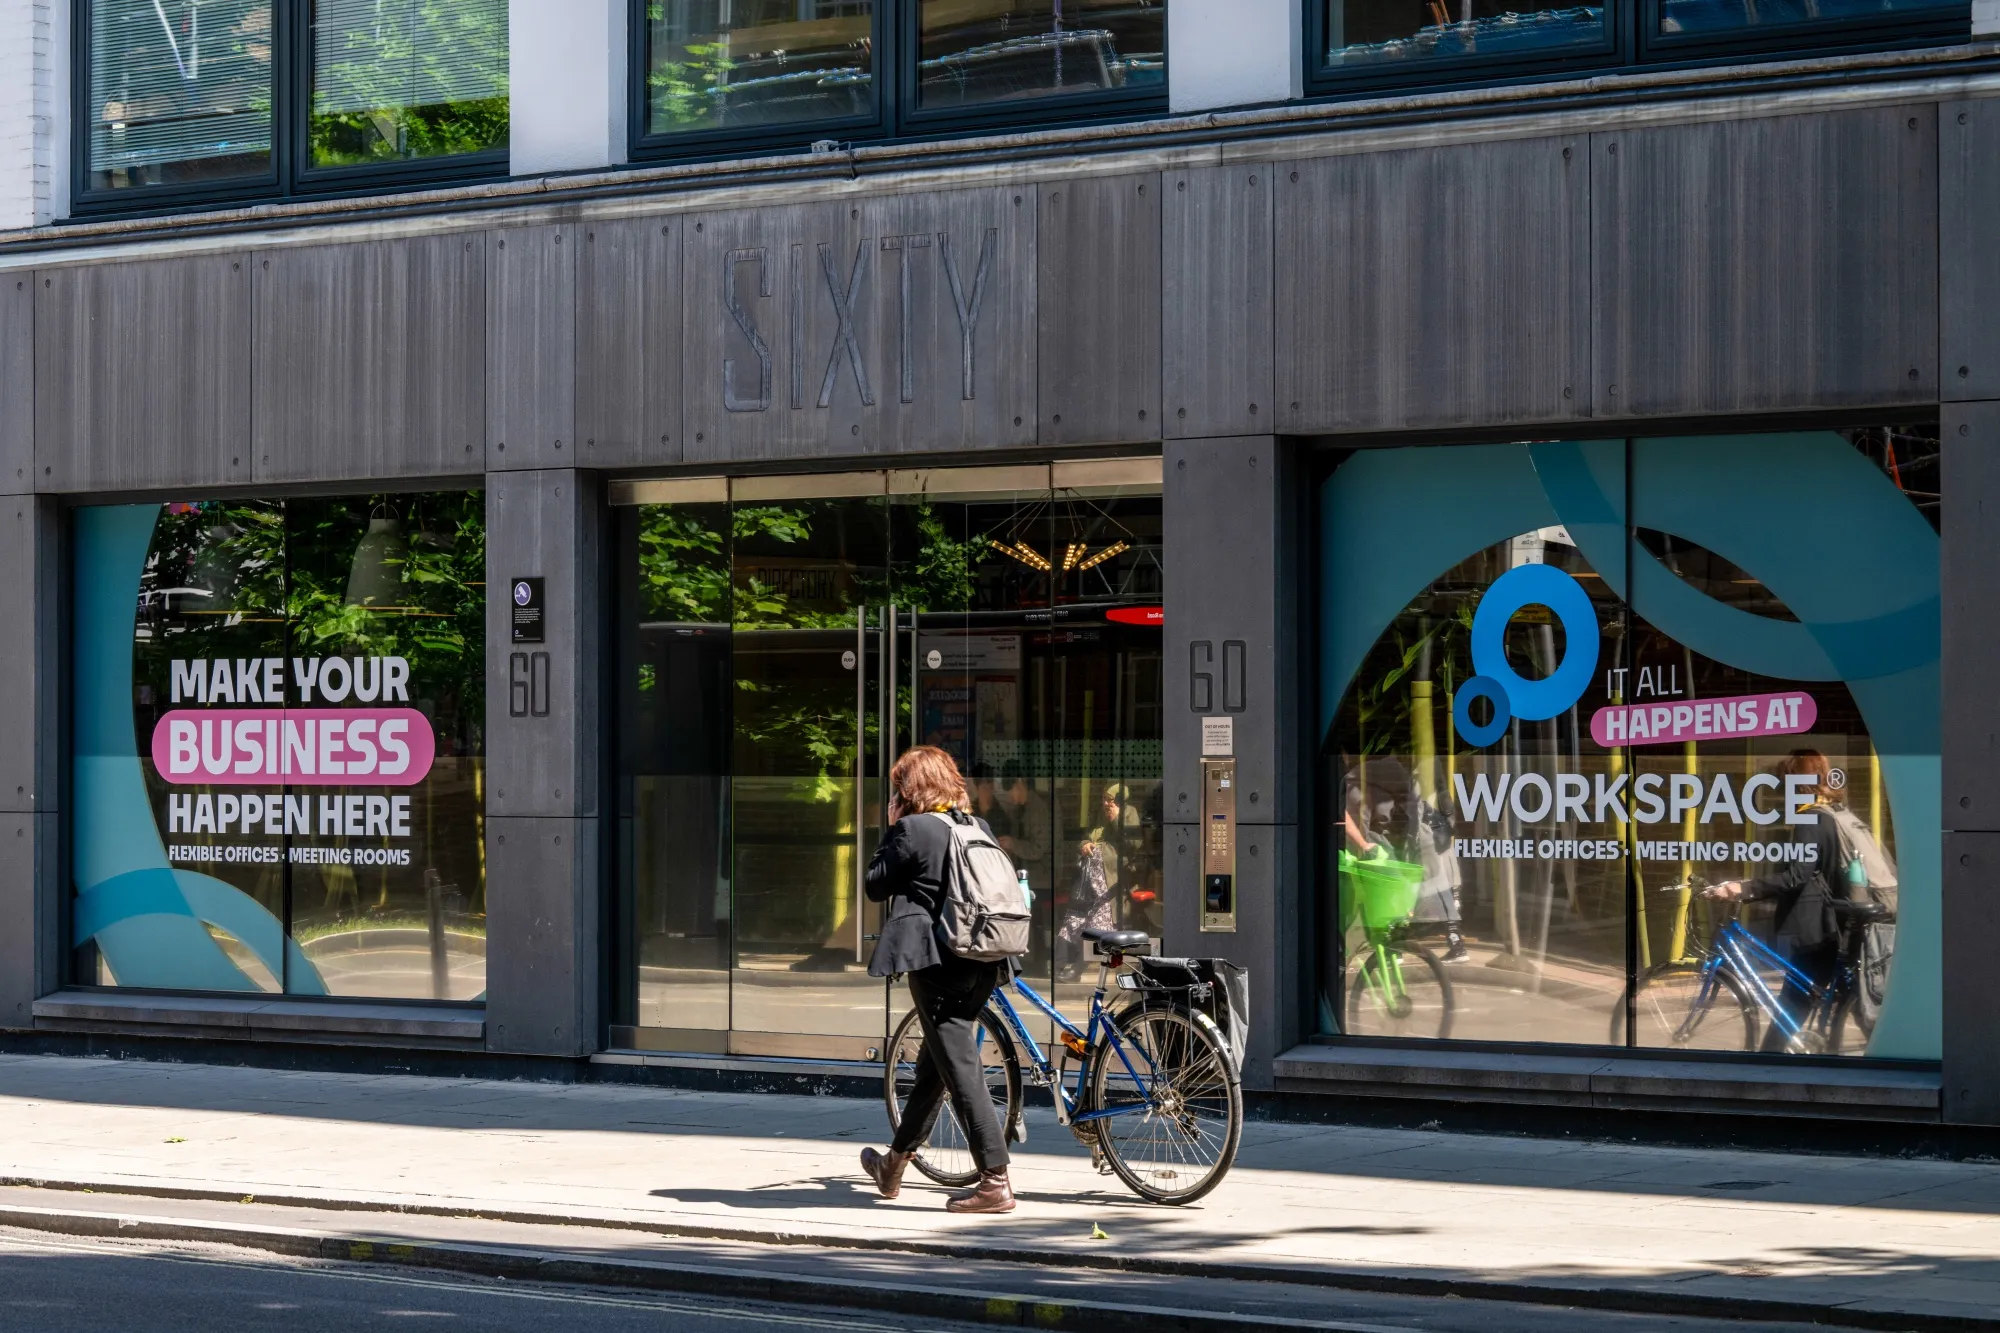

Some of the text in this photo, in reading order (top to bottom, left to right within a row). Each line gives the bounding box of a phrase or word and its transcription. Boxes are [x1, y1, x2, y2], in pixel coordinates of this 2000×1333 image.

[724, 228, 998, 412] SIXTY
[171, 656, 410, 703] MAKE YOUR
[510, 651, 550, 717] 60
[1189, 639, 1247, 713] 60
[1607, 664, 1683, 699] IT ALL
[1606, 697, 1803, 741] HAPPENS AT
[169, 719, 411, 775] BUSINESS
[169, 793, 411, 837] HAPPEN HERE
[169, 845, 410, 866] FLEXIBLE OFFICES MEETING ROOMS
[1454, 838, 1818, 863] FLEXIBLE OFFICES MEETING ROOMS
